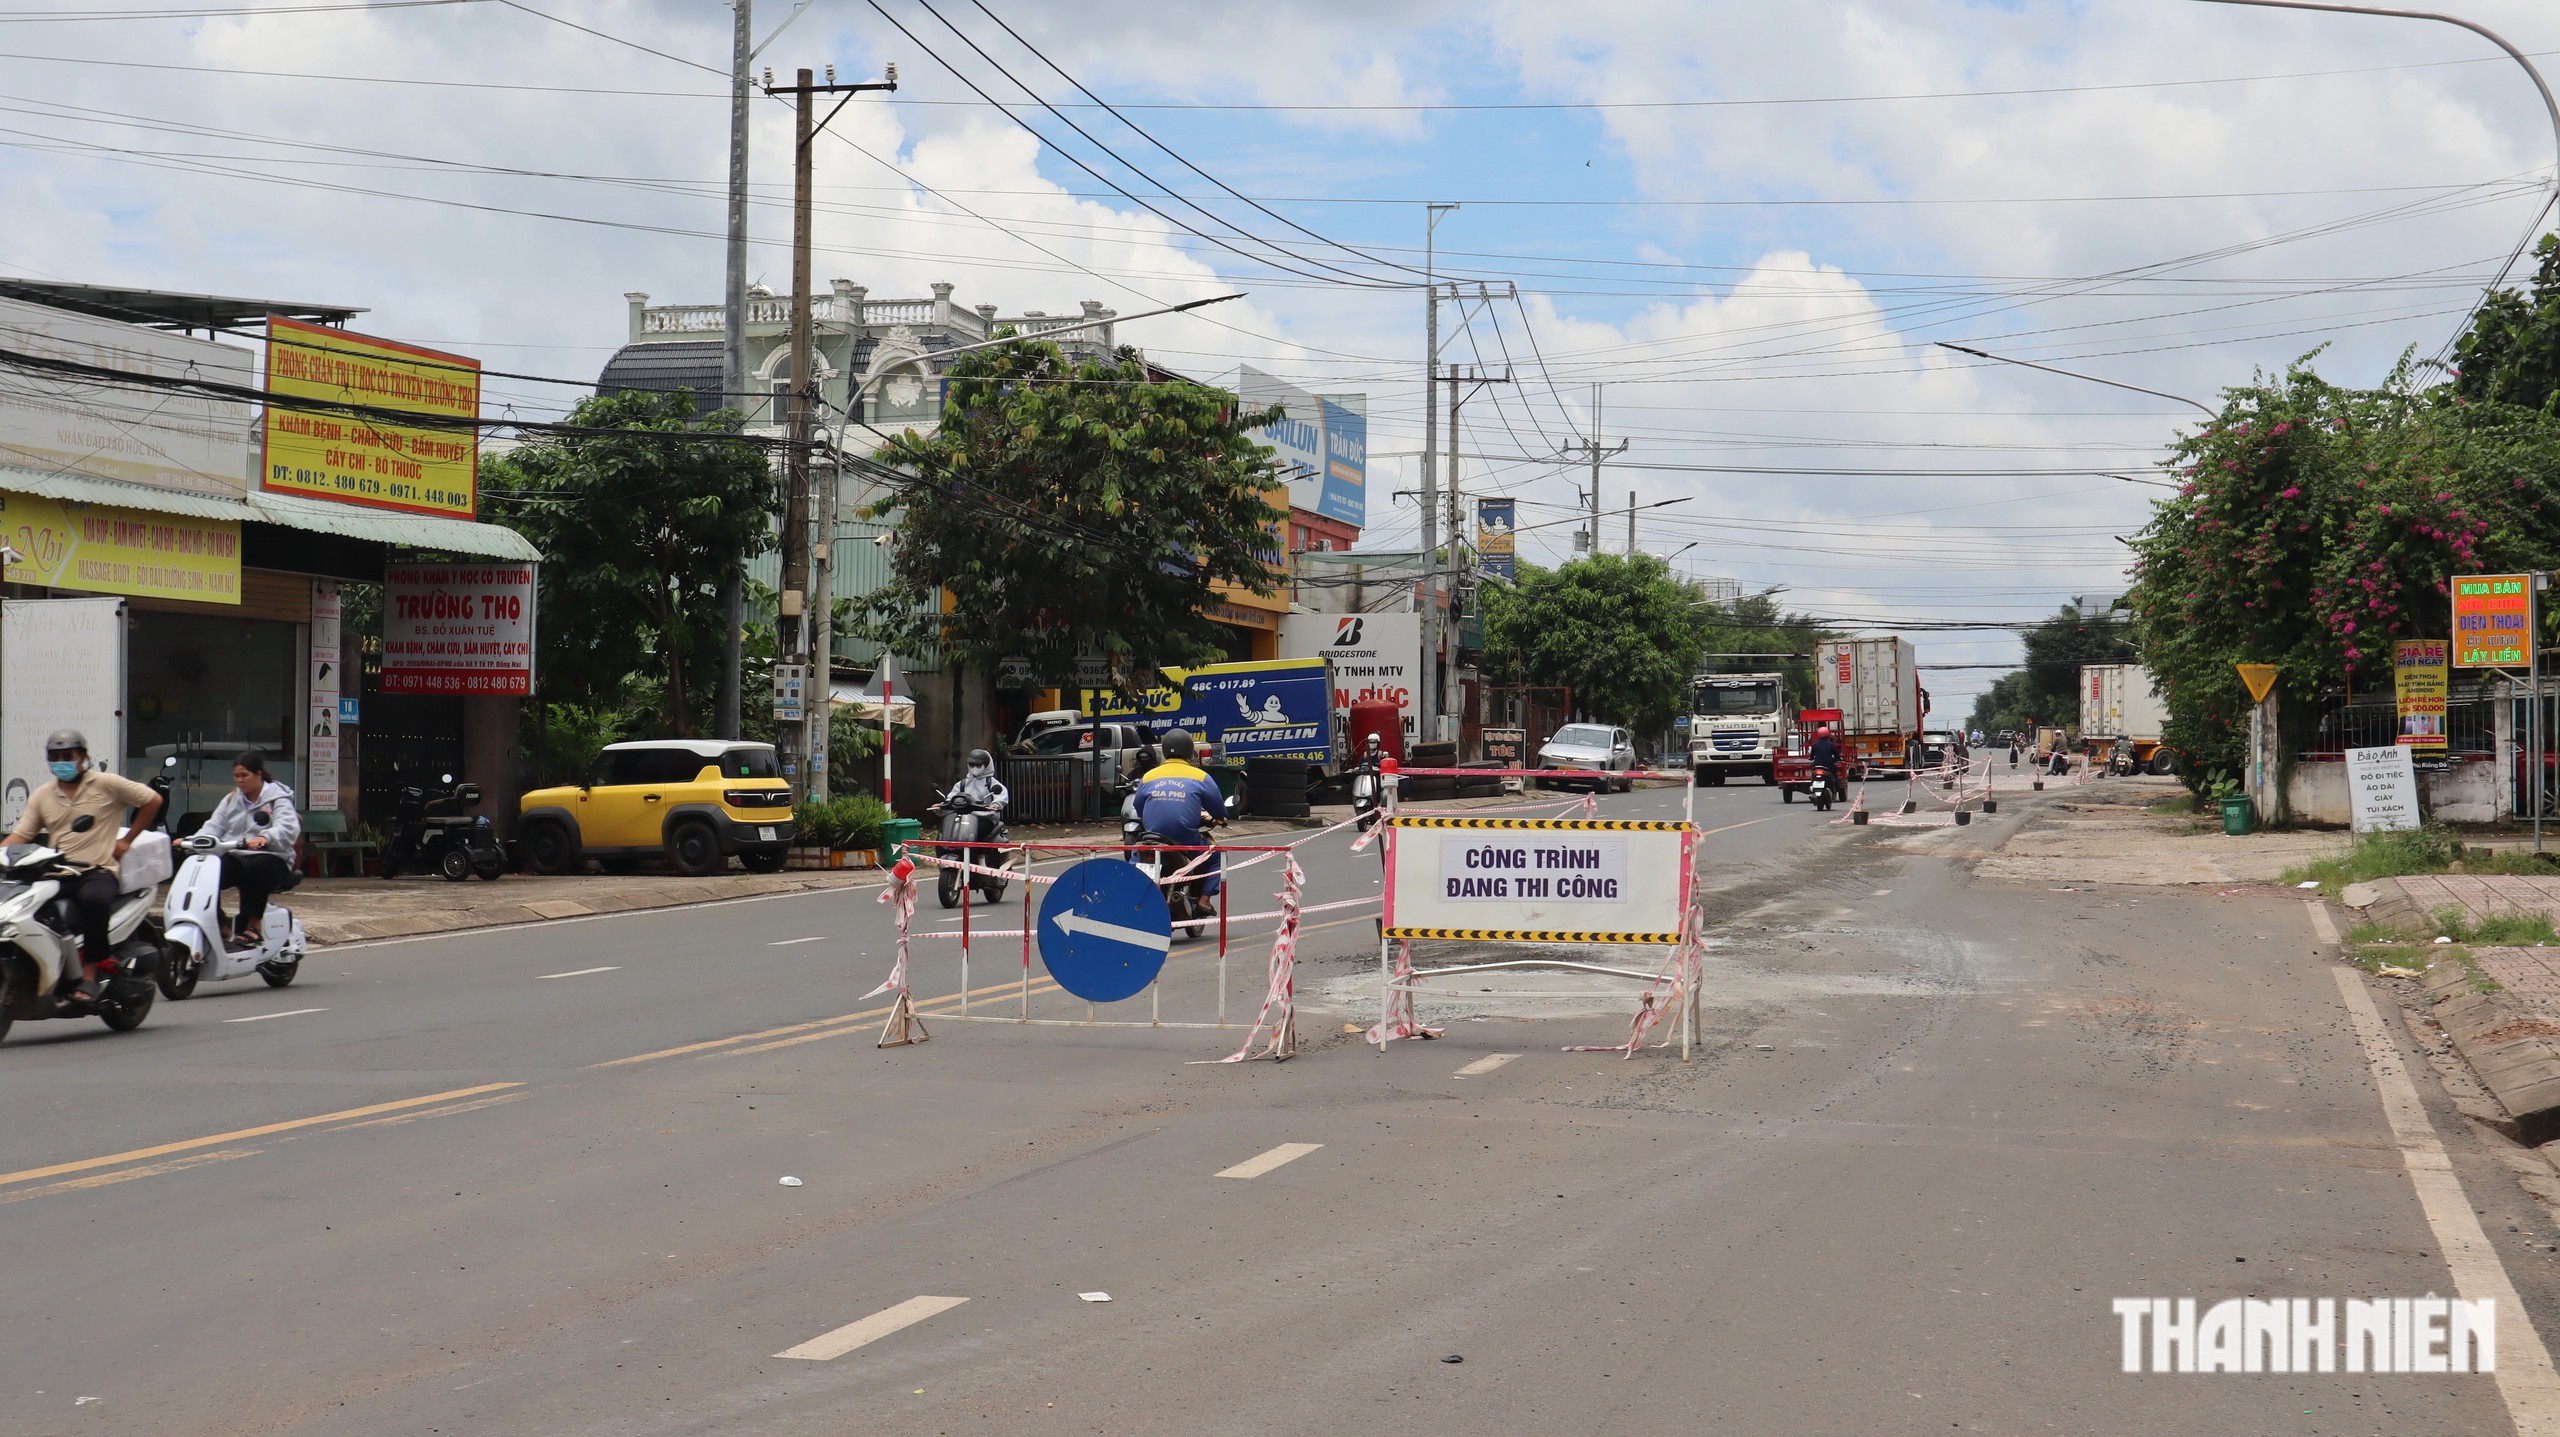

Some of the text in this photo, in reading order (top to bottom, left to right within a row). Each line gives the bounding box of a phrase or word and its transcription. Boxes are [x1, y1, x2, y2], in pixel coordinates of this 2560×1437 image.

[276, 346, 308, 378] PHÒNG
[351, 364, 359, 388] Y
[359, 366, 376, 400] HỌC
[278, 412, 310, 436] KHÁM
[313, 416, 341, 443] BỆNH
[411, 433, 434, 457] BẤM
[435, 441, 466, 465] HUYỆT
[1263, 415, 1319, 456] SAILUN
[1330, 426, 1365, 468] TRẦN ĐỨC
[325, 445, 422, 480] CẤY CHỈ BÓ THUỐC
[1291, 458, 1316, 483] TIRE
[272, 464, 468, 507] ĐT: 0812. 480 679 0971. 448 003
[21, 570, 36, 582] 228
[78, 558, 111, 583] MASSAGE
[112, 563, 131, 585] BODY
[187, 571, 204, 592] SINH
[208, 573, 225, 592] NAM
[451, 570, 459, 585] Y
[460, 570, 479, 589] HỌC
[496, 564, 531, 585] TRUYỀN
[2460, 580, 2522, 596] MUA BÁN
[395, 588, 521, 627] TRƯỜNG THỌ
[415, 622, 496, 638] BS. ĐỖ XUÂN TUỆ
[2459, 611, 2525, 633] ĐIỆN THOẠI
[385, 638, 405, 655] KHÁM
[503, 638, 517, 656] CẤY
[517, 640, 529, 656] CHỈ
[2486, 633, 2519, 646] KÍNH
[1318, 650, 1378, 659] BRIDGESTONE
[2397, 642, 2445, 658] GIÁ RẺ
[2463, 647, 2521, 663] LẤY LIỀN
[1344, 666, 1403, 677] TNHH MTV
[385, 674, 527, 690] ĐT: 0971 448 536 0812 480 679
[1191, 678, 1257, 692] 48C 017.89
[344, 700, 353, 713] 18
[2398, 696, 2417, 704] LUÔN
[2412, 704, 2445, 712] 500.000
[1151, 718, 1173, 730] ĐỘNG
[1179, 716, 1194, 727] CỨU
[1195, 715, 1207, 727] HỘ
[1221, 728, 1318, 744] MICHELIN
[1307, 751, 1325, 761] 416
[1489, 744, 1515, 757] TÓC
[2356, 748, 2398, 761] Bảo Anh
[2386, 771, 2404, 779] TIỆC
[2366, 782, 2395, 791] ÁO DÀI
[2374, 793, 2393, 802] GIÀY
[2366, 803, 2405, 813] TÚI XÁCH
[1465, 843, 1601, 871] CÔNG TRÌNH
[1446, 872, 1620, 901] ĐANG THI CÔNG
